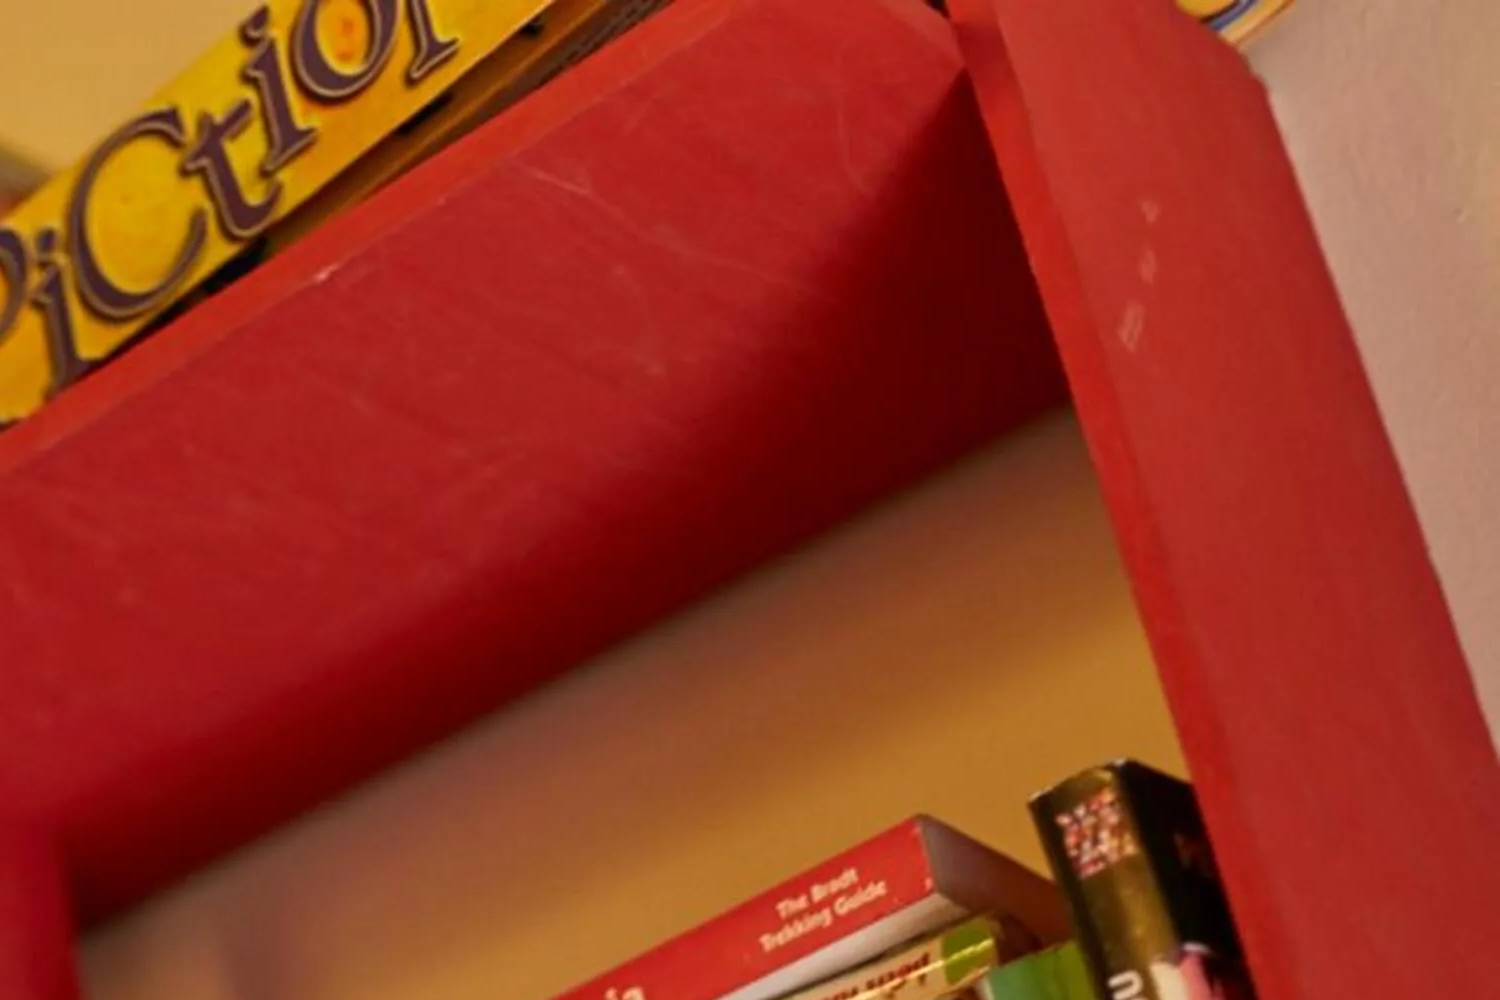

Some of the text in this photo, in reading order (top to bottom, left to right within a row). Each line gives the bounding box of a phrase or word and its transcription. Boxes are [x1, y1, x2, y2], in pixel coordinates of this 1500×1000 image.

[759, 880, 888, 952] Trekking Guide
[775, 868, 858, 920] The Bradt
